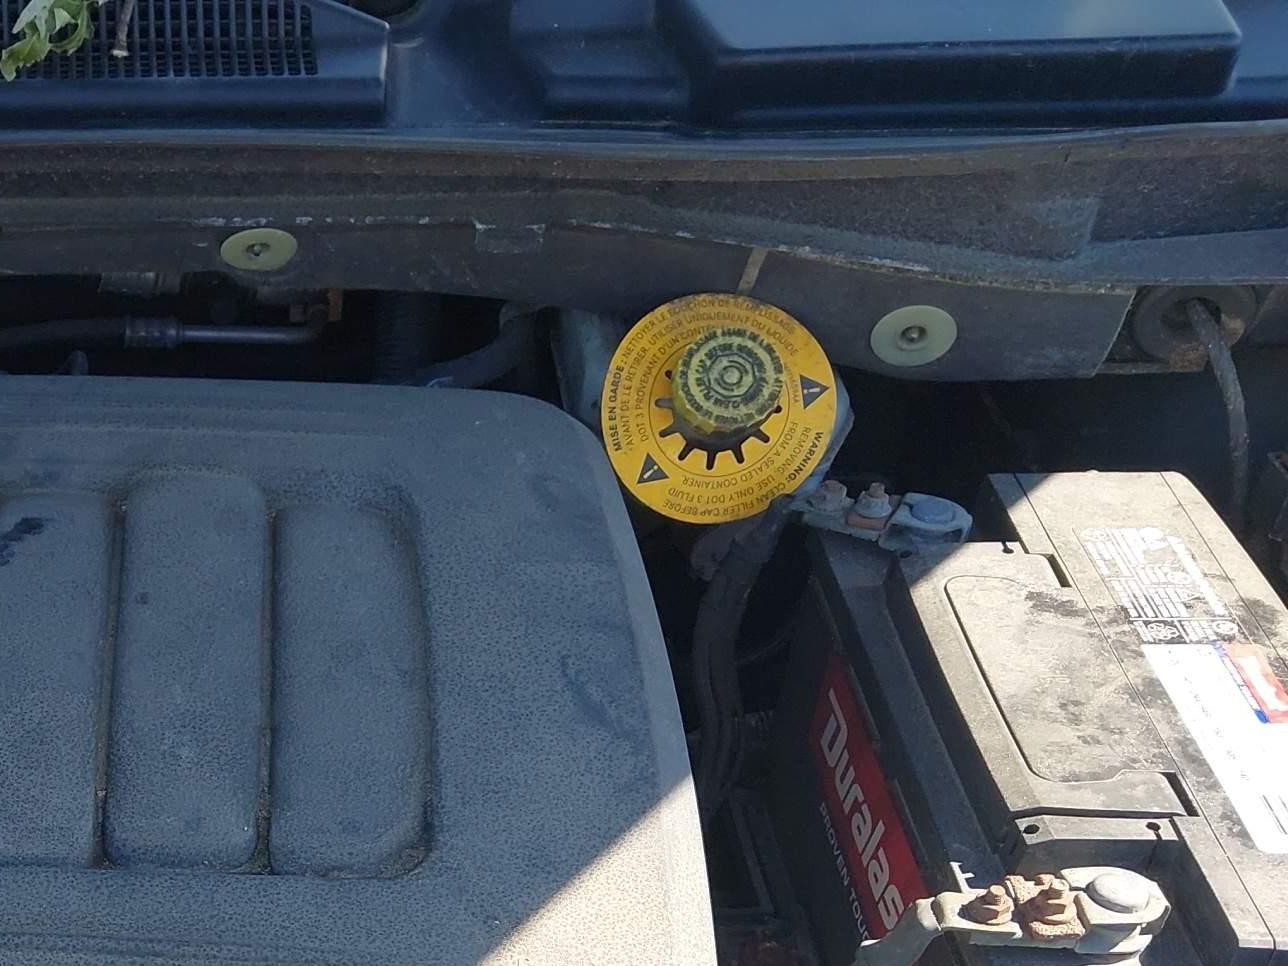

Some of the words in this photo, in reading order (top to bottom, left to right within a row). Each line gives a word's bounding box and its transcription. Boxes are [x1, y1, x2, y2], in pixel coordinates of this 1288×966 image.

[751, 320, 767, 331] DU
[621, 319, 655, 358] NETTOYER
[635, 354, 660, 409] PROVENANT
[623, 386, 632, 397] LE
[608, 406, 617, 421] EN
[620, 400, 630, 412] DE
[609, 426, 622, 452] MISE
[620, 415, 634, 446] AVANT
[636, 424, 649, 442] DOT
[779, 421, 799, 450] FROM
[785, 432, 824, 482] WARNING:
[740, 456, 775, 481] SEALED
[757, 474, 775, 491] USE
[668, 487, 694, 503] FLUID
[707, 494, 726, 505] DOT
[728, 487, 754, 501] ONLY
[756, 482, 786, 504] CLEAN
[663, 498, 698, 516] BEFORE
[700, 507, 720, 517] CAP
[723, 501, 754, 516] FILLER
[821, 688, 904, 930] Duralas
[818, 802, 849, 886] PROVEN
